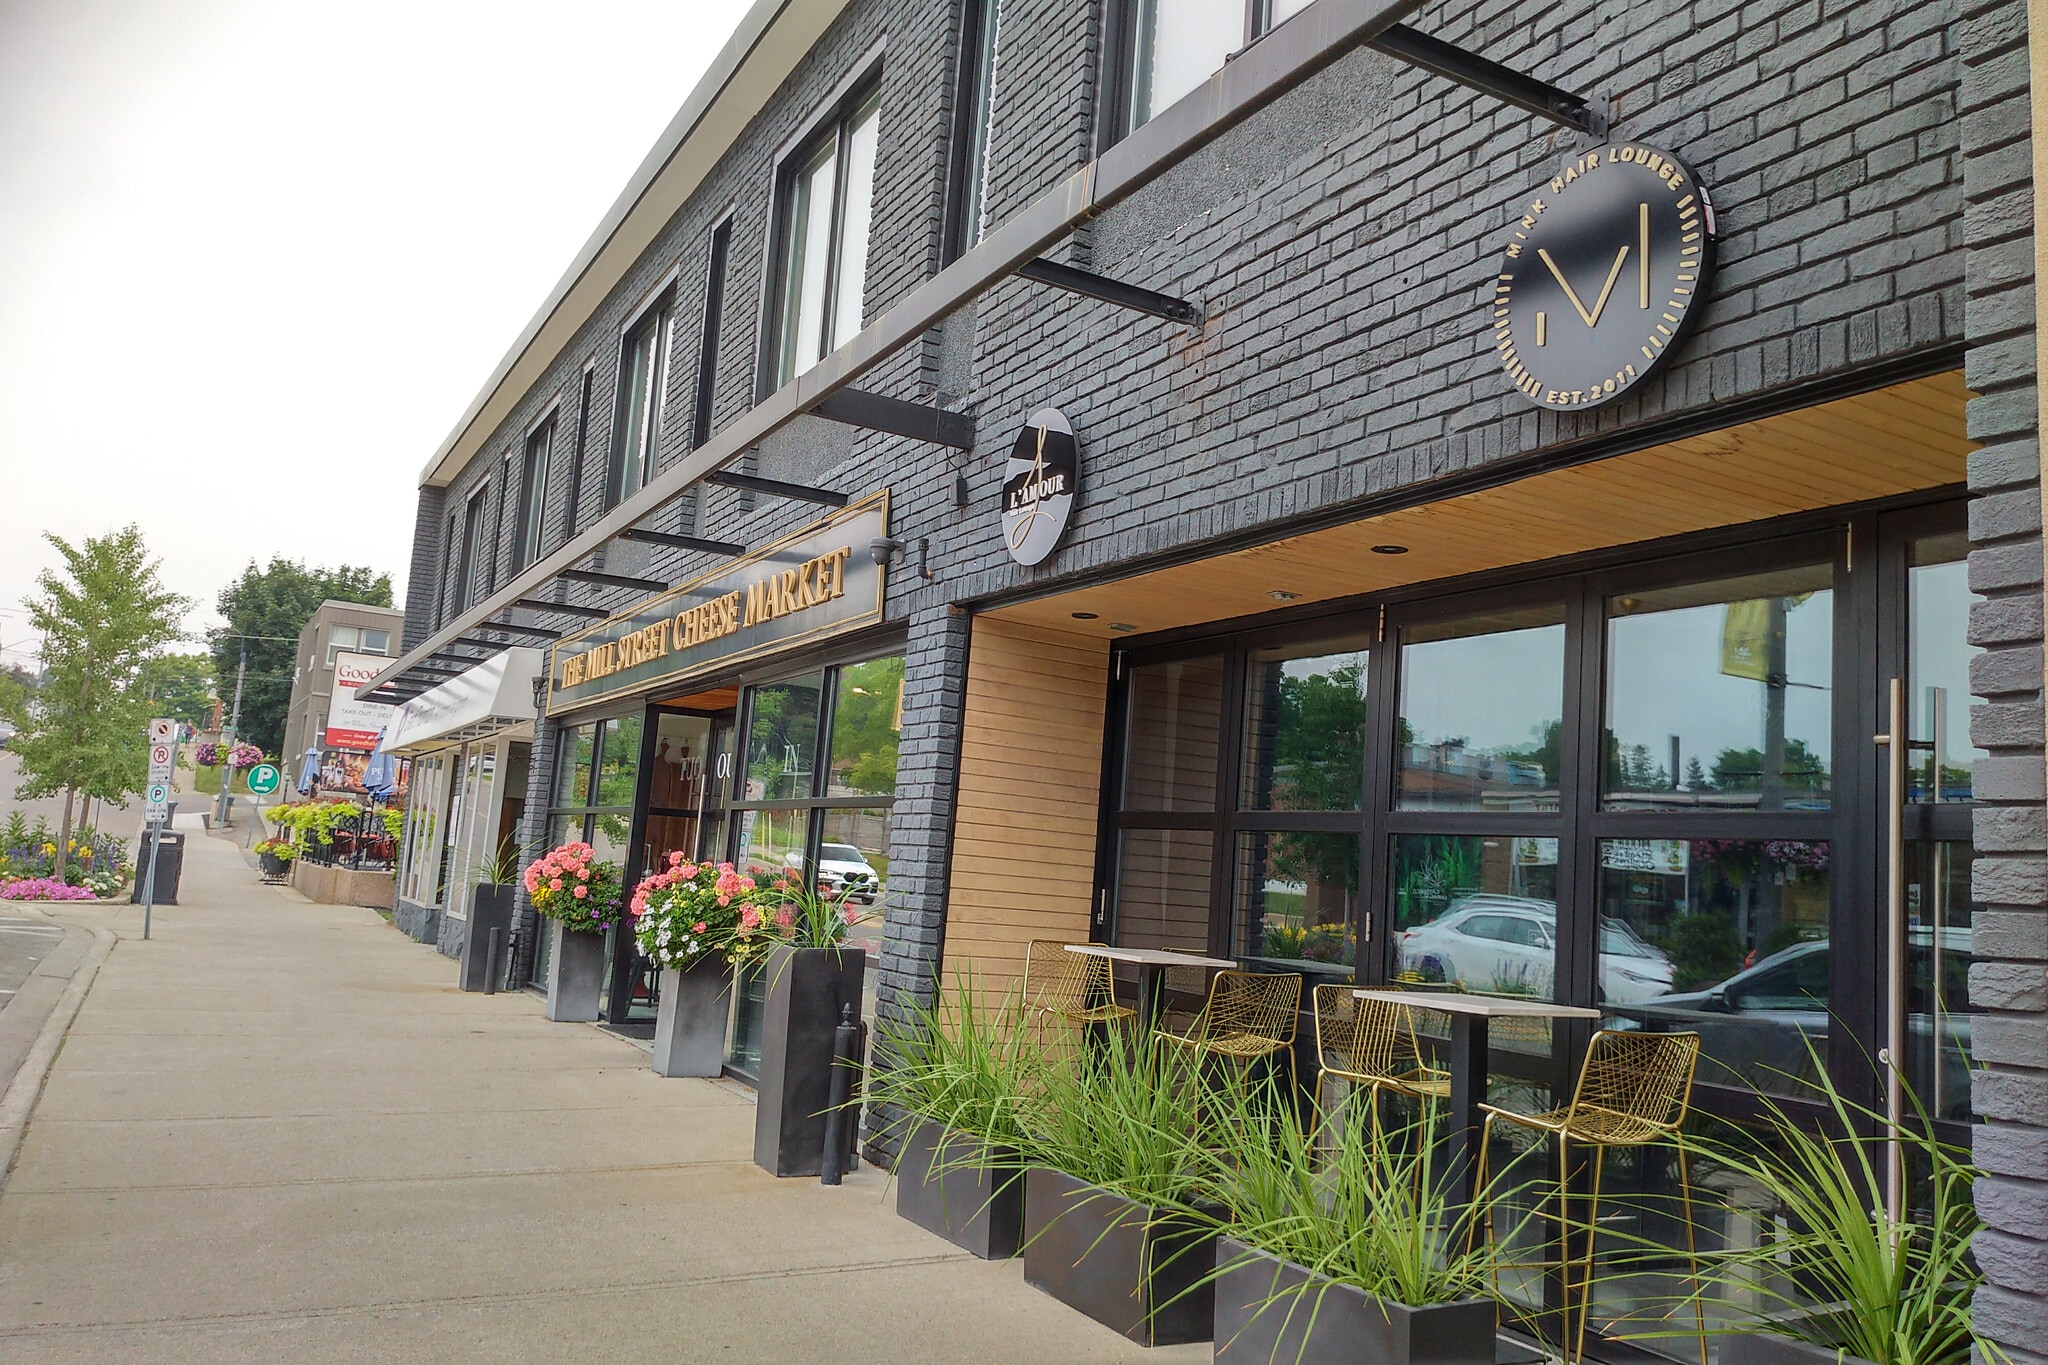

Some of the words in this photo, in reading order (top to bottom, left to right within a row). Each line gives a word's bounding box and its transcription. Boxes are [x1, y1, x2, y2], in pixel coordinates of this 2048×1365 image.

[1506, 199, 1547, 259] MINK
[1550, 153, 1600, 194] HAIR
[1608, 147, 1684, 191] LOUNGE
[561, 652, 586, 689] THE
[584, 641, 617, 682] MILL
[616, 618, 671, 670] STREET
[672, 590, 741, 651] CHEESE
[743, 546, 852, 629] MARKET
[256, 767, 274, 784] P
